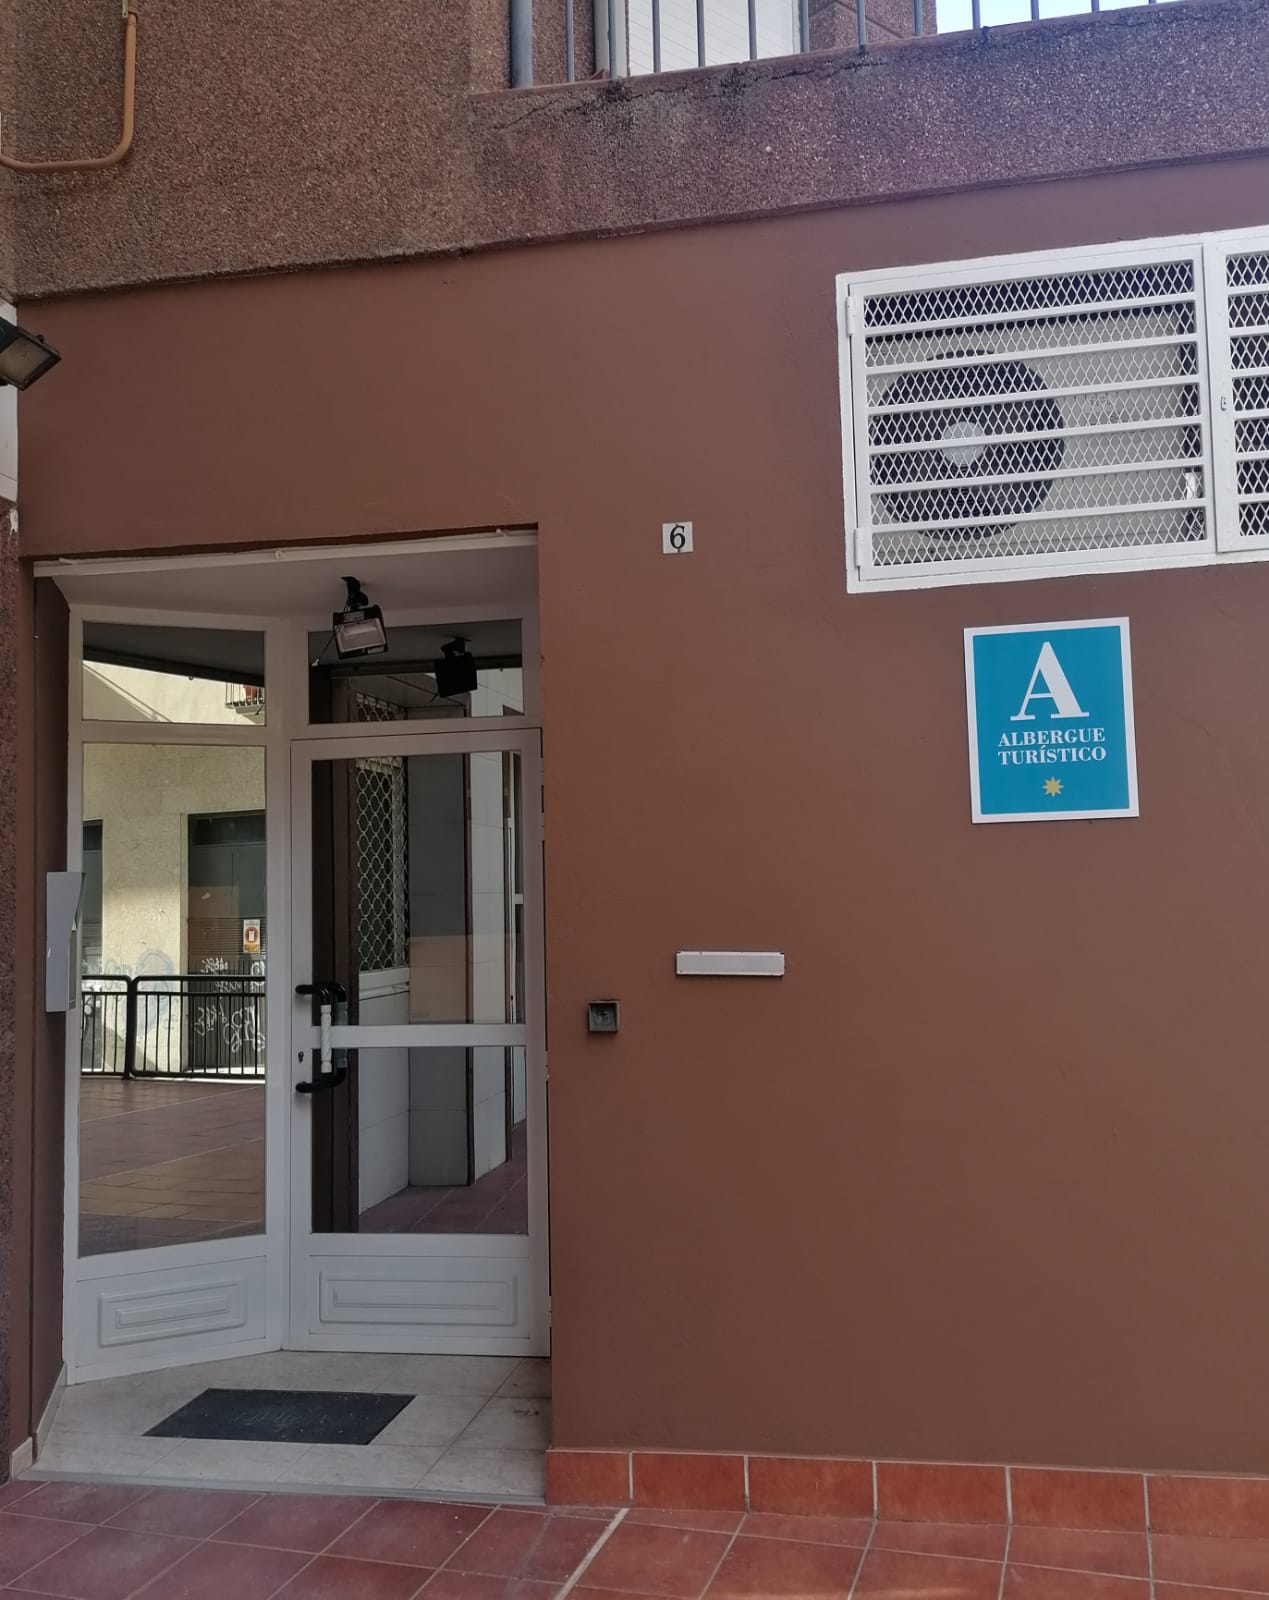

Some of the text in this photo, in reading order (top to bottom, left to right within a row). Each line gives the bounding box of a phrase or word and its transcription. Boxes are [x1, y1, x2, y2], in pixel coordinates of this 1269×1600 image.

[670, 524, 686, 550] 6
[1010, 641, 1090, 721] A
[998, 728, 1105, 747] ALBERGUE
[998, 745, 1107, 765] TURÍSTICO
